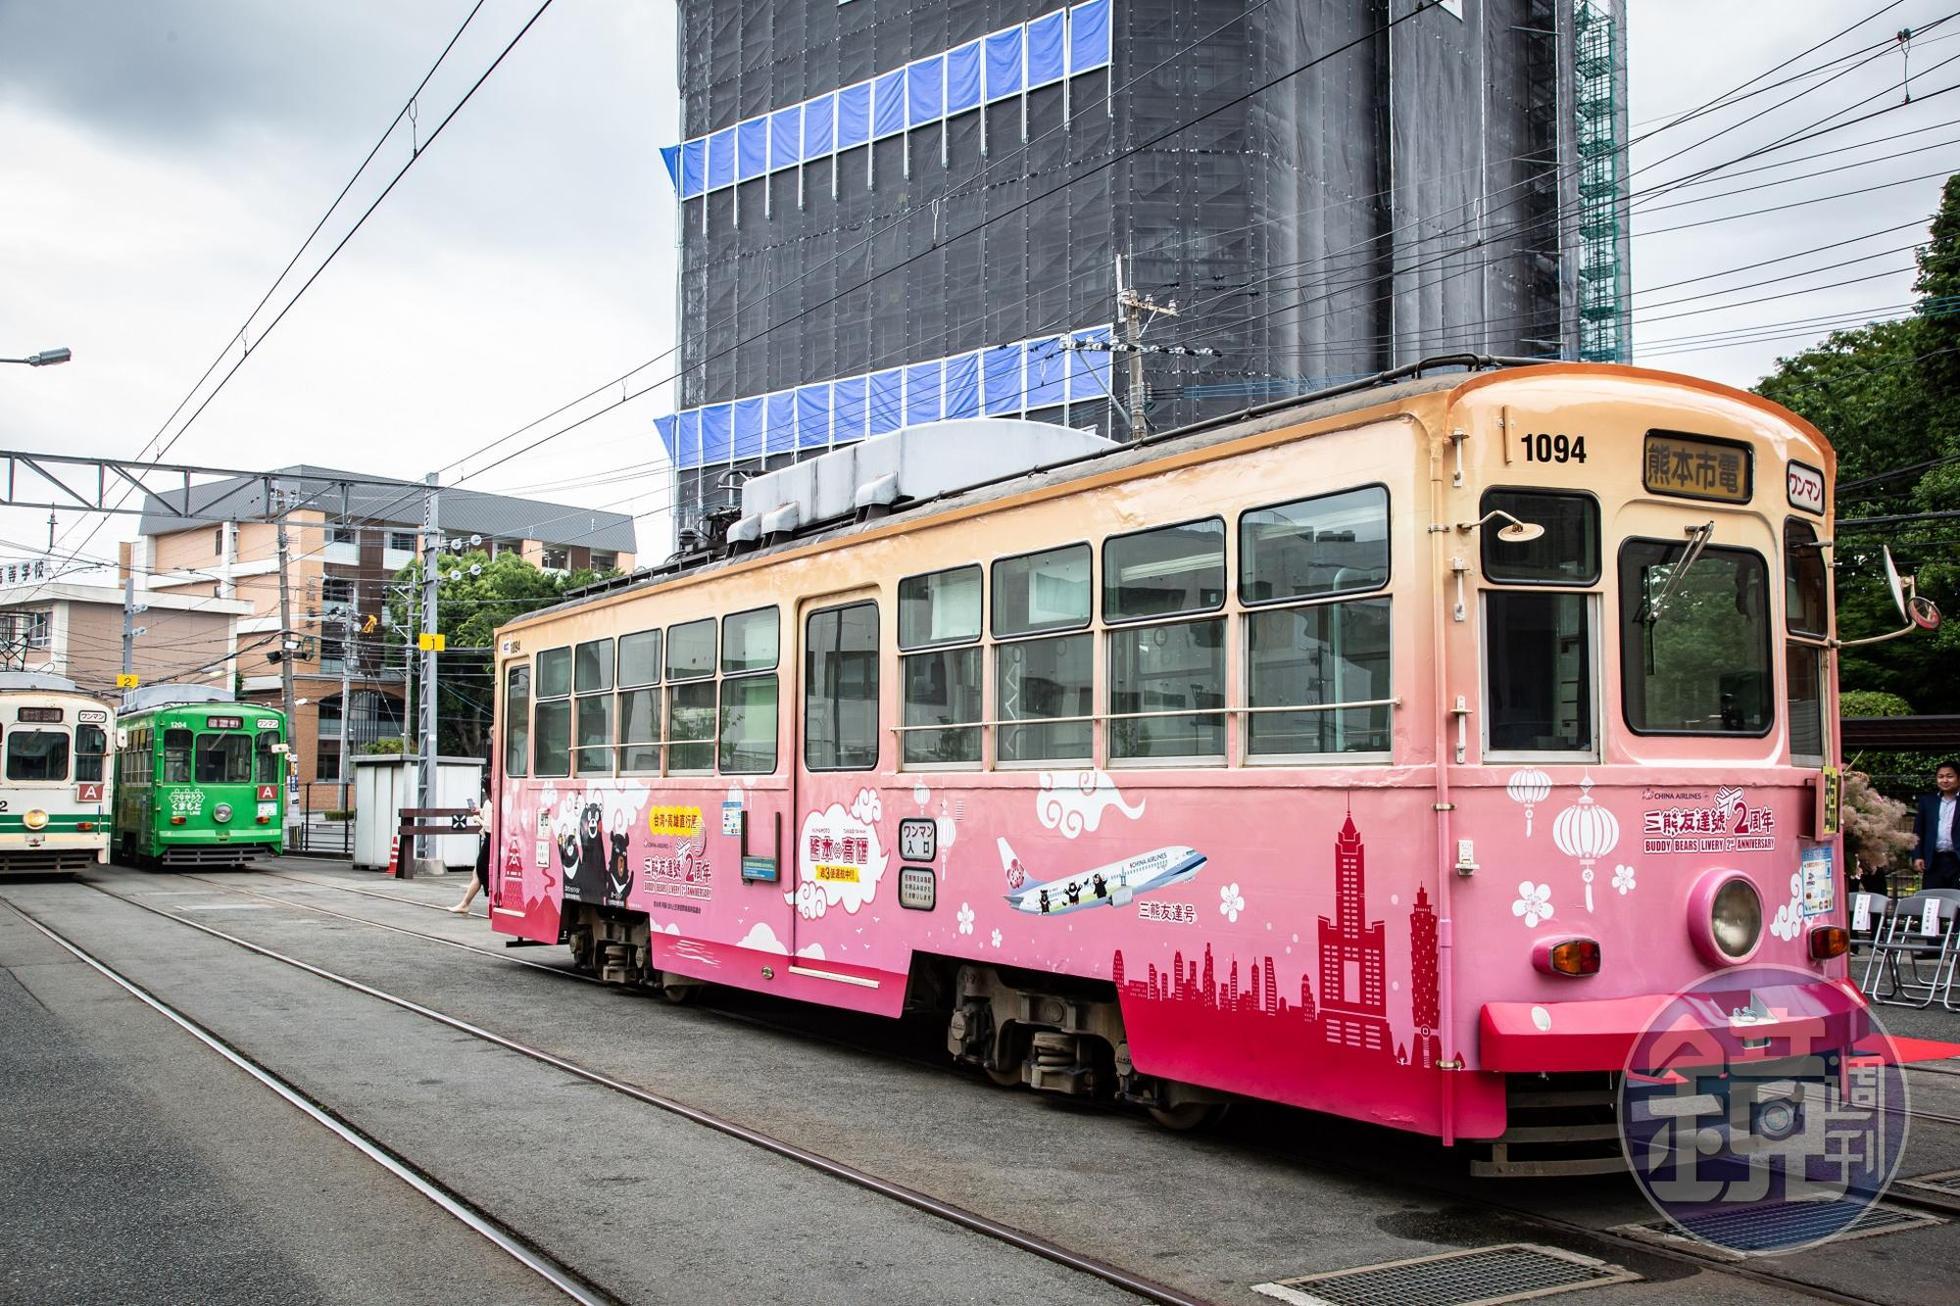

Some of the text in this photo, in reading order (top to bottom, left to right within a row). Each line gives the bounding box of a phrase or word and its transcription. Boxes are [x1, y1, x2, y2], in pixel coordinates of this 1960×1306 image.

[1521, 433, 1587, 464] 1094
[1647, 443, 1740, 494] 熊本市電
[1789, 472, 1821, 502] ワンマン
[124, 677, 132, 687] 2
[80, 712, 105, 721] ワンマン
[84, 785, 97, 798] A
[262, 786, 273, 798] A
[1654, 792, 1702, 800] CHINA AIRLINES
[903, 825, 934, 839] ワンマン
[906, 839, 930, 854] 入口
[1645, 840, 1671, 852] BUDDY
[1675, 840, 1698, 851] BEARS
[1701, 839, 1723, 850] LIVERY
[1737, 838, 1774, 850] ANNIVERSARY
[1139, 901, 1196, 924] 三熊友達号
